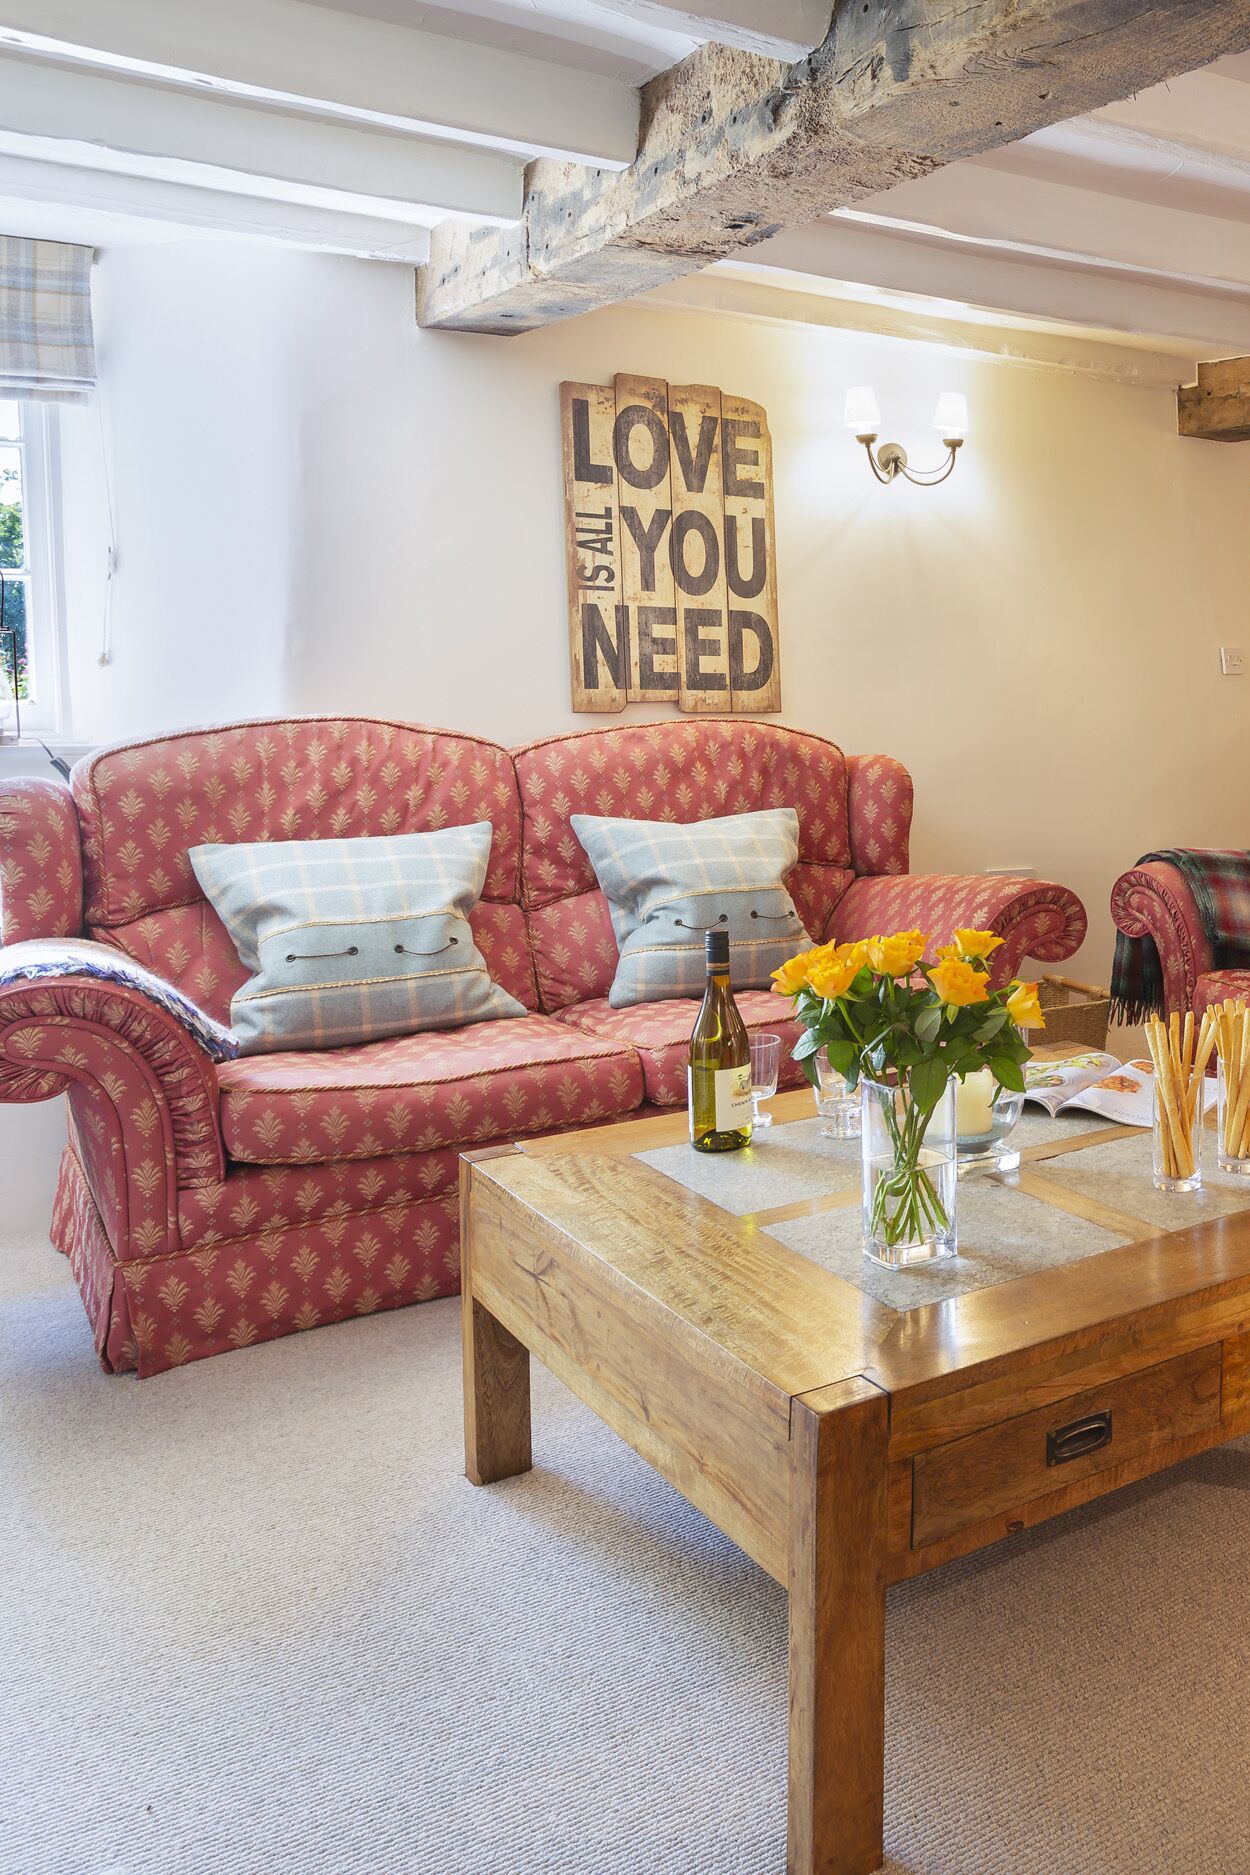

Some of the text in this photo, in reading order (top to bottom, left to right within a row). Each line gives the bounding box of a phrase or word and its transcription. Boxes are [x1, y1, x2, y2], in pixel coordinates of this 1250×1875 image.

[571, 398, 765, 498] LOVE
[575, 506, 616, 592] IS ALL
[618, 505, 767, 599] YOU
[581, 603, 774, 692] NEED
